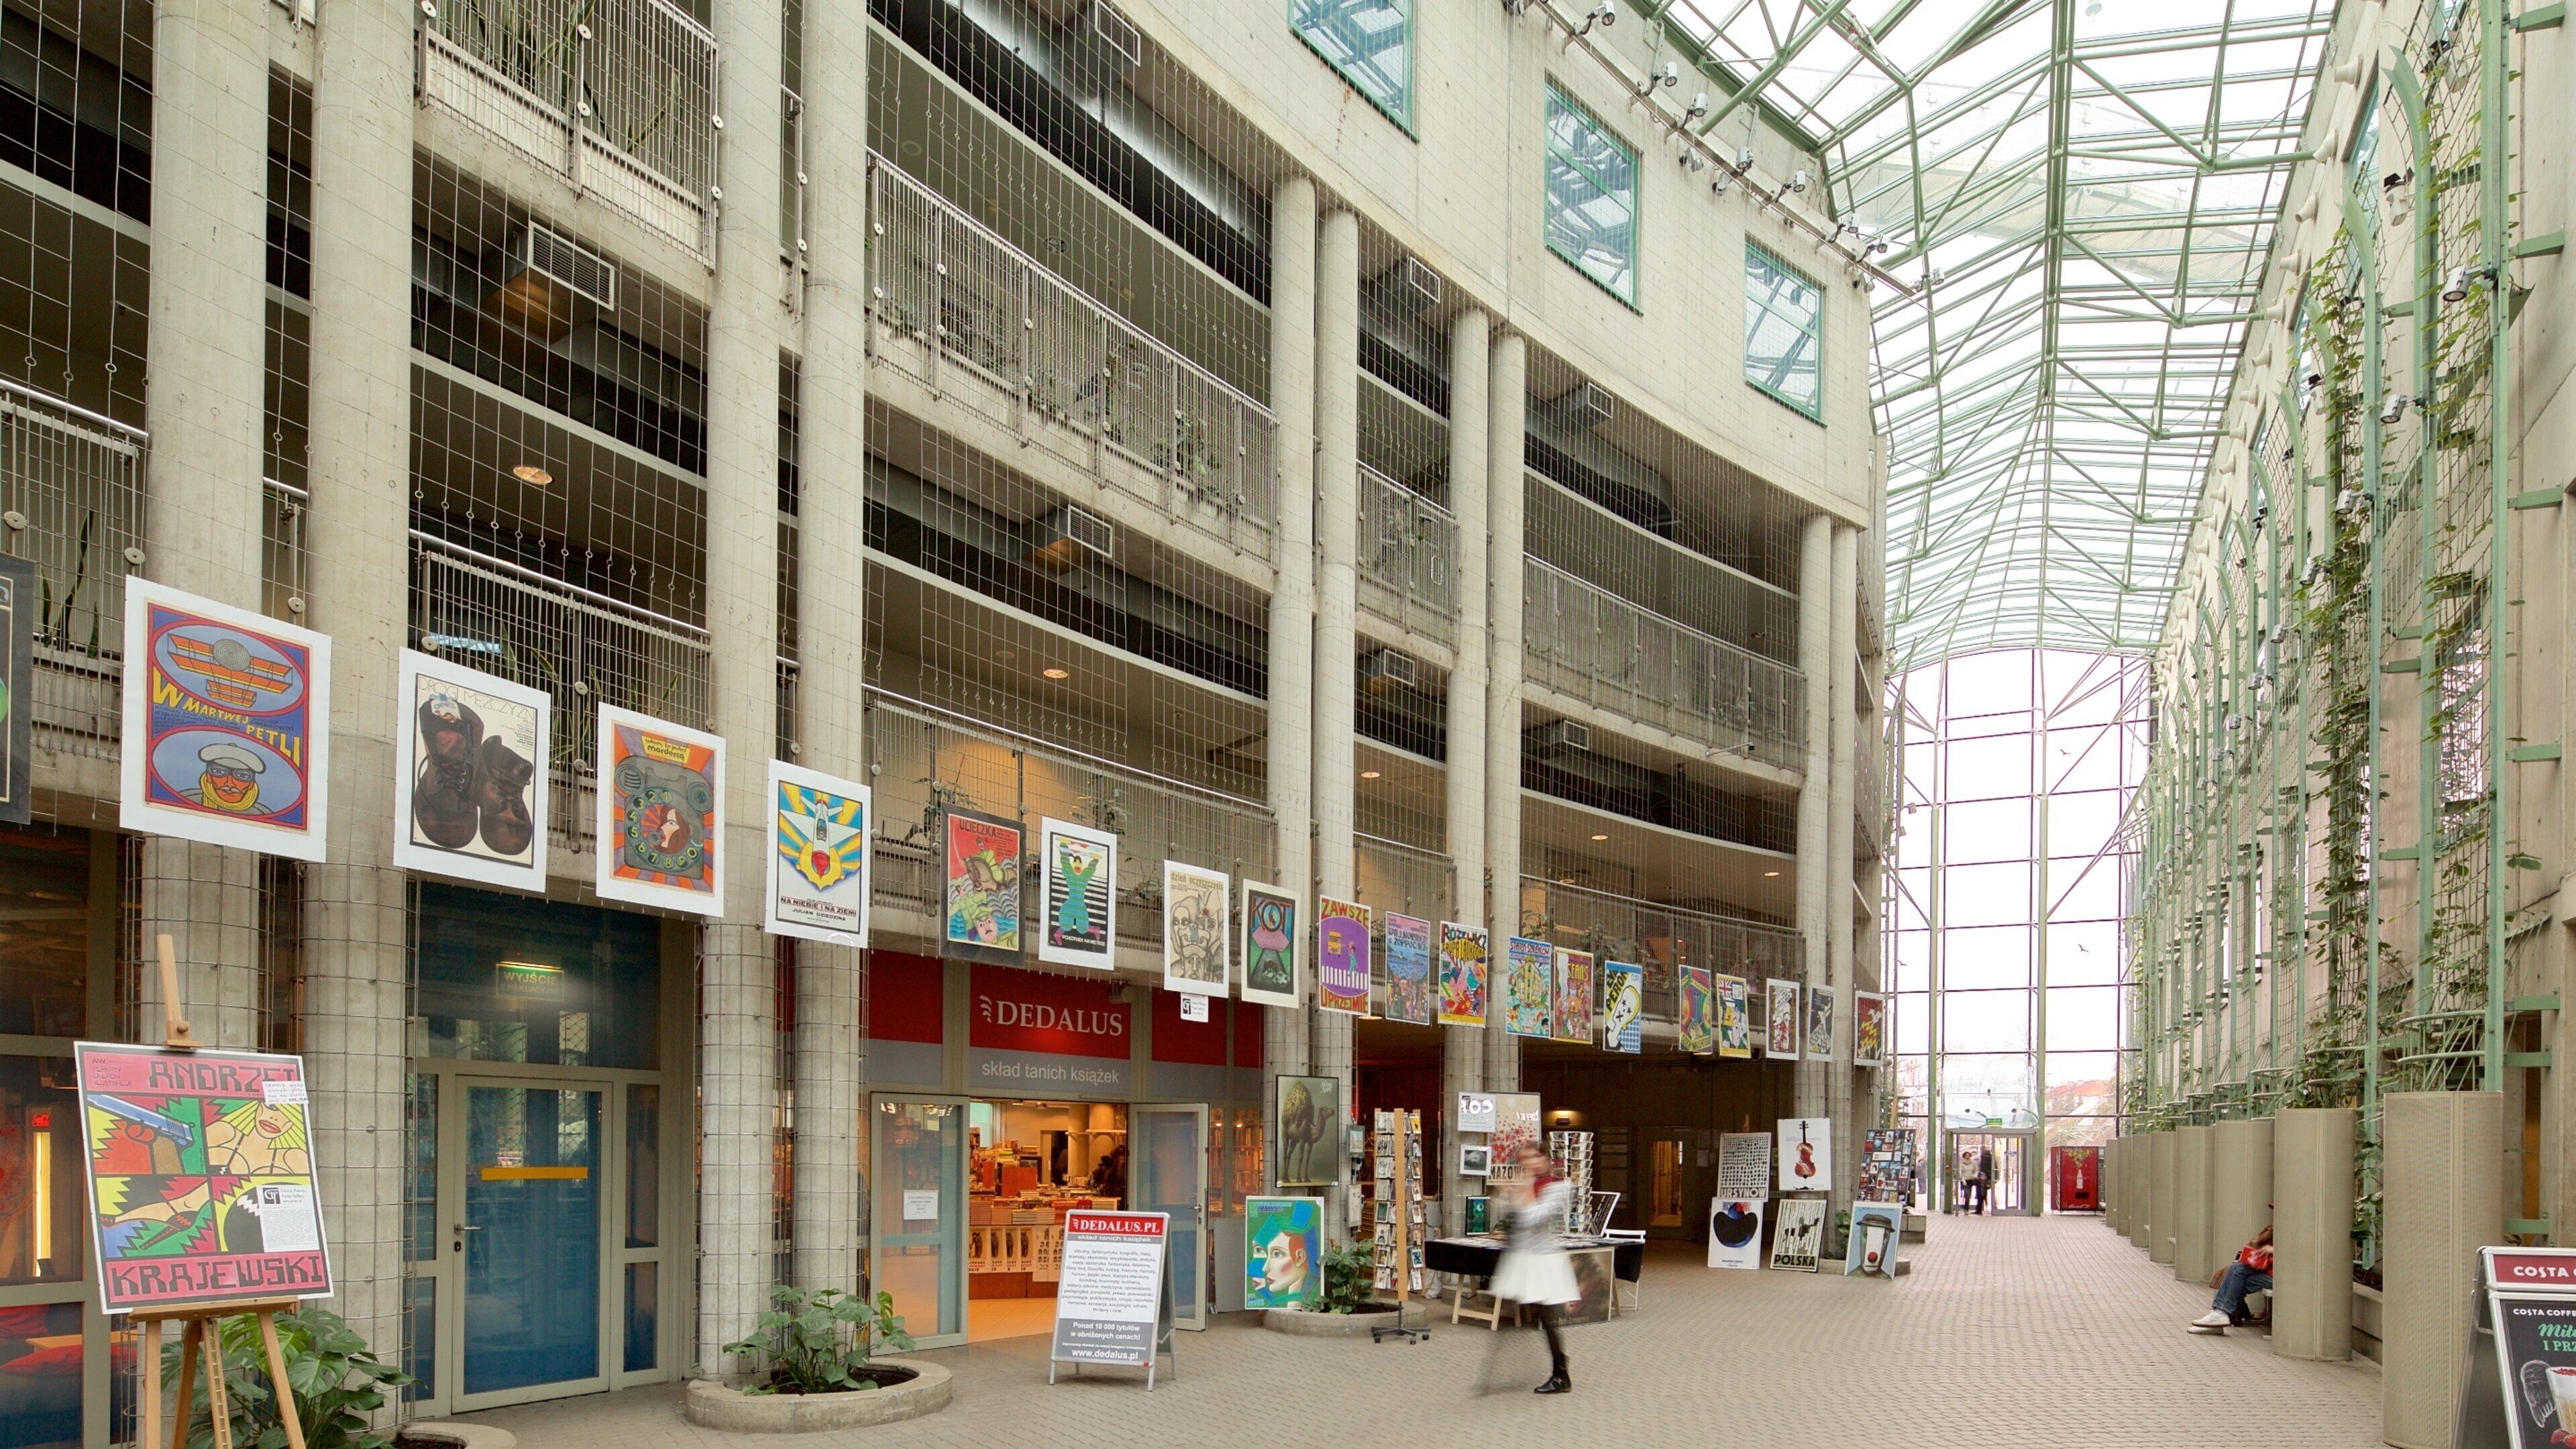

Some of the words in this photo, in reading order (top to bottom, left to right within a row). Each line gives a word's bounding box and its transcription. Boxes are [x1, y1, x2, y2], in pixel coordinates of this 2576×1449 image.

[152, 665, 184, 708] W
[182, 697, 249, 724] MARTWEJ
[419, 676, 459, 700] DROGI
[637, 797, 643, 810] 3
[648, 791, 656, 804] 2
[664, 791, 669, 803] 1
[629, 810, 637, 822] 4
[631, 826, 638, 839] 5
[959, 818, 997, 838] UCIECZKA
[638, 843, 646, 853] 6
[687, 847, 698, 859] 0
[650, 853, 657, 863] 7
[665, 857, 671, 869] 8
[679, 857, 686, 866] 9
[793, 900, 818, 909] NIEBIE
[837, 908, 857, 916] ZIEMI
[1252, 896, 1293, 932] KOT
[1322, 897, 1369, 926] ZAWSZE
[504, 971, 558, 985] WYJŚCIE
[1567, 963, 1589, 982] SEANS
[996, 1000, 1123, 1036] DEDALUS
[981, 1061, 1020, 1077] skład
[1025, 1063, 1066, 1081] tanich
[1071, 1067, 1119, 1085] książek
[1080, 1220, 1160, 1232] DEDALUS.PL
[1773, 1254, 1817, 1267] POLSKA
[111, 1255, 323, 1297] KRAJEWSKI
[2513, 1266, 2569, 1278] COSTA
[2513, 1308, 2544, 1316] COSTA
[1073, 1322, 1093, 1330] Ponad
[1116, 1324, 1140, 1332] tytułów
[1077, 1330, 1114, 1340] obniżonych
[2542, 1340, 2549, 1350] I
[1071, 1349, 1138, 1361] www.dedalus.pl
